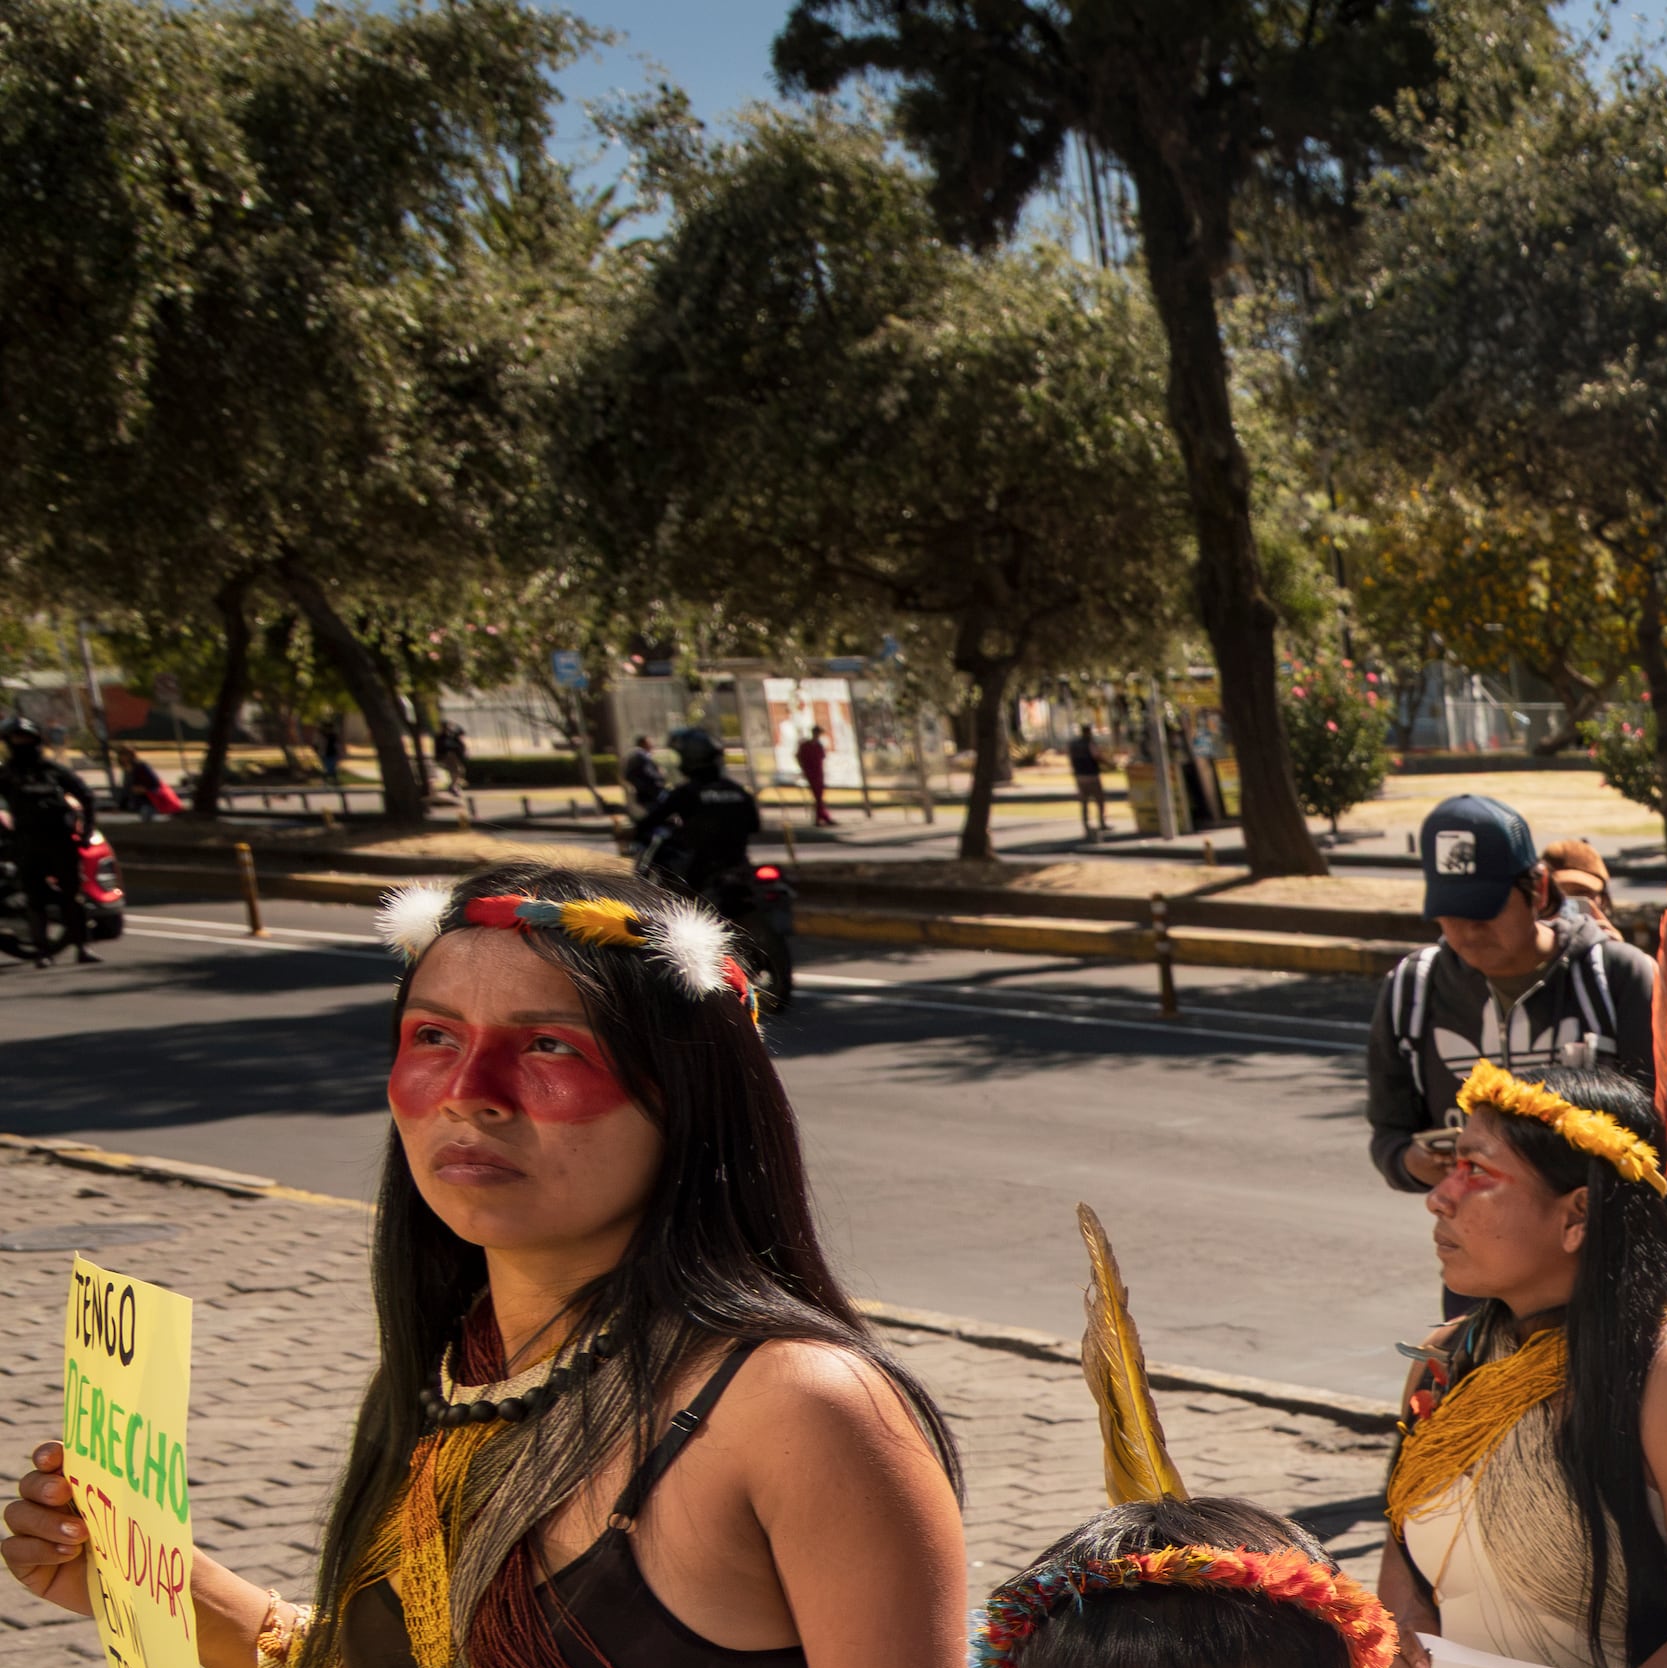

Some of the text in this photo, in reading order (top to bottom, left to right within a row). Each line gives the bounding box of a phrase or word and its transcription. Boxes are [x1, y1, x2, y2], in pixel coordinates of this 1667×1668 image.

[75, 1271, 135, 1367] TENGO
[64, 1357, 188, 1525] DERECHO
[96, 1567, 125, 1639] EN
